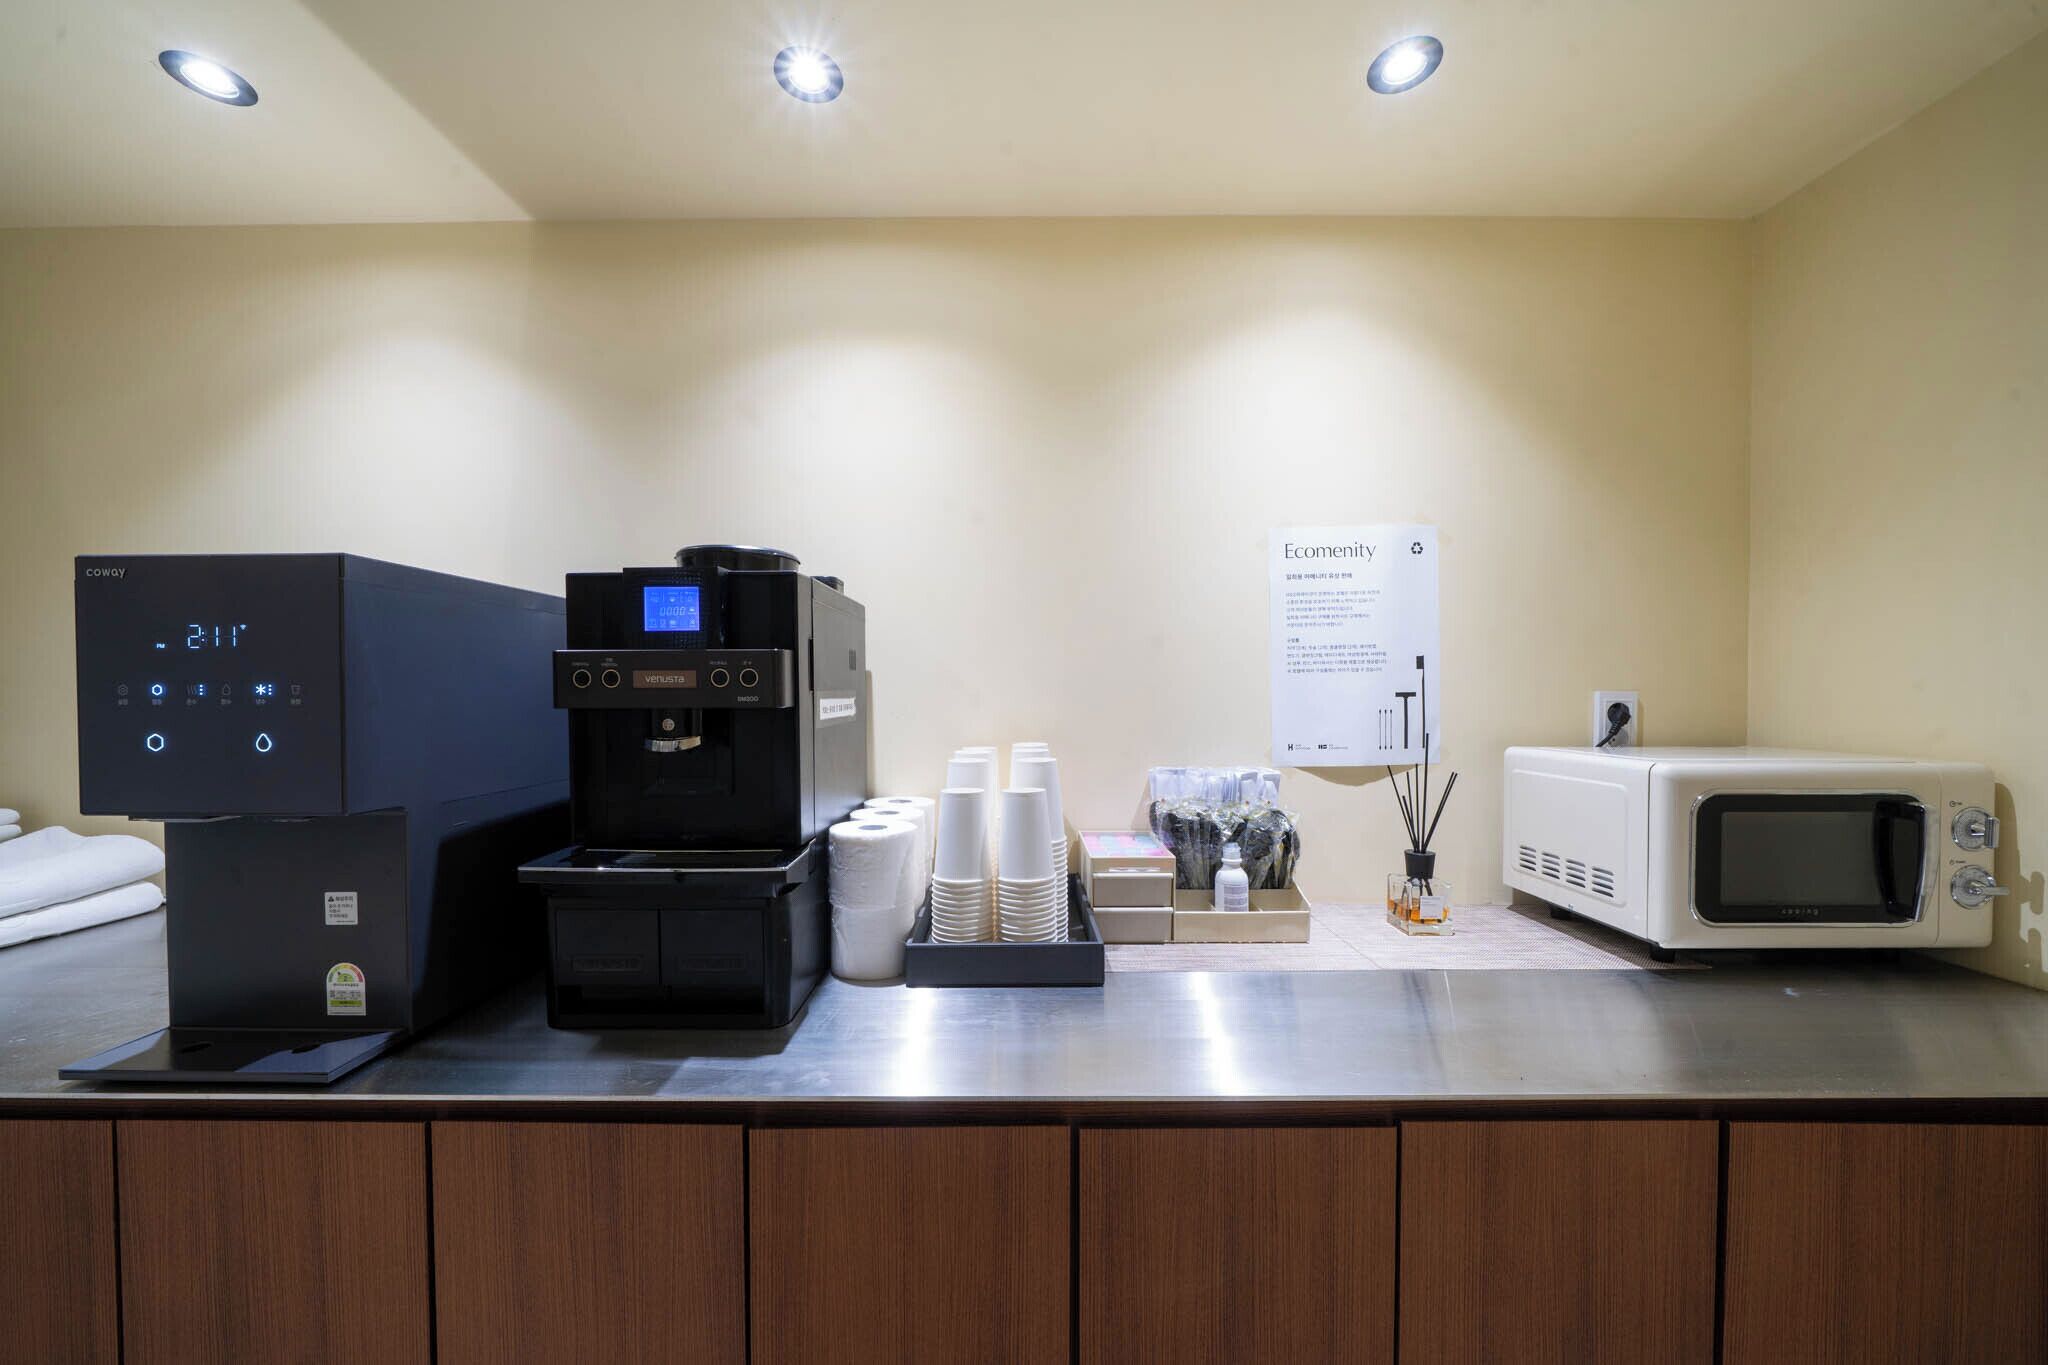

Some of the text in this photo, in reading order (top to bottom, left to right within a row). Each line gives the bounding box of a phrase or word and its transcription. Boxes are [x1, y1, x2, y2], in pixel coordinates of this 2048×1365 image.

[1284, 541, 1377, 562] Ecomenity
[86, 567, 126, 579] coway
[187, 624, 236, 649] 2:11
